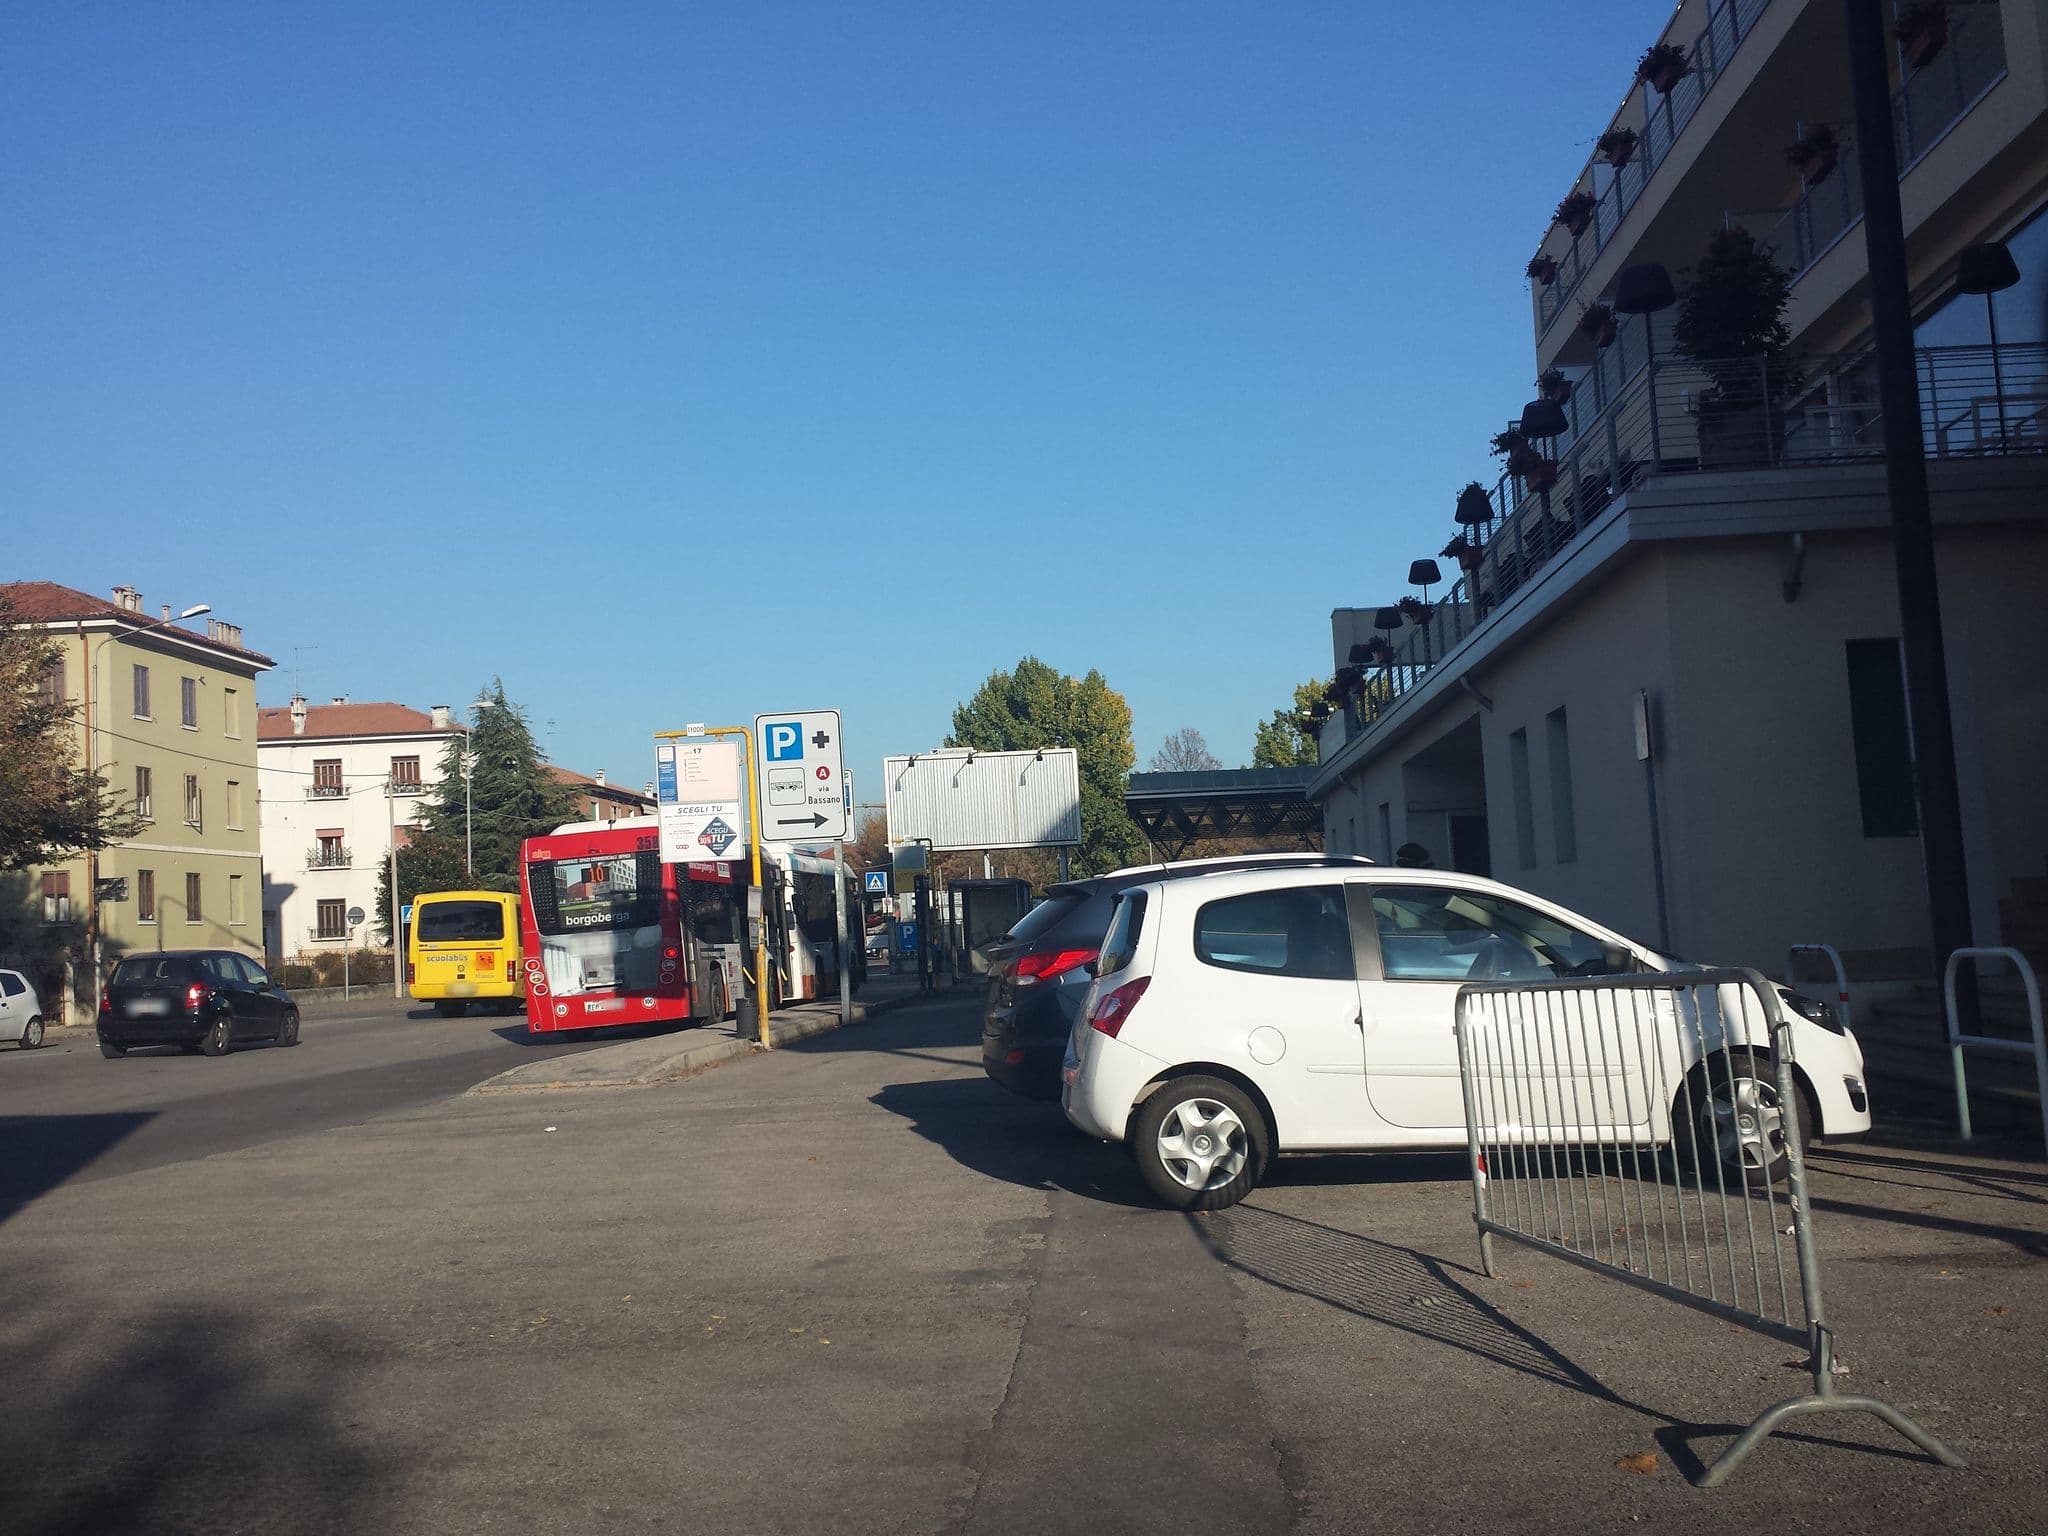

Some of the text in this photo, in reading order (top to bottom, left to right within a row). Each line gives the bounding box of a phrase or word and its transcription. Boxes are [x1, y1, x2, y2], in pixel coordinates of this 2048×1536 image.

[772, 726, 797, 758] P
[808, 795, 841, 805] Bassano
[677, 806, 708, 814] SCEGLI
[589, 867, 603, 883] 10
[565, 911, 630, 926] borgoberga
[902, 925, 914, 939] P
[426, 953, 468, 963] scuolabus
